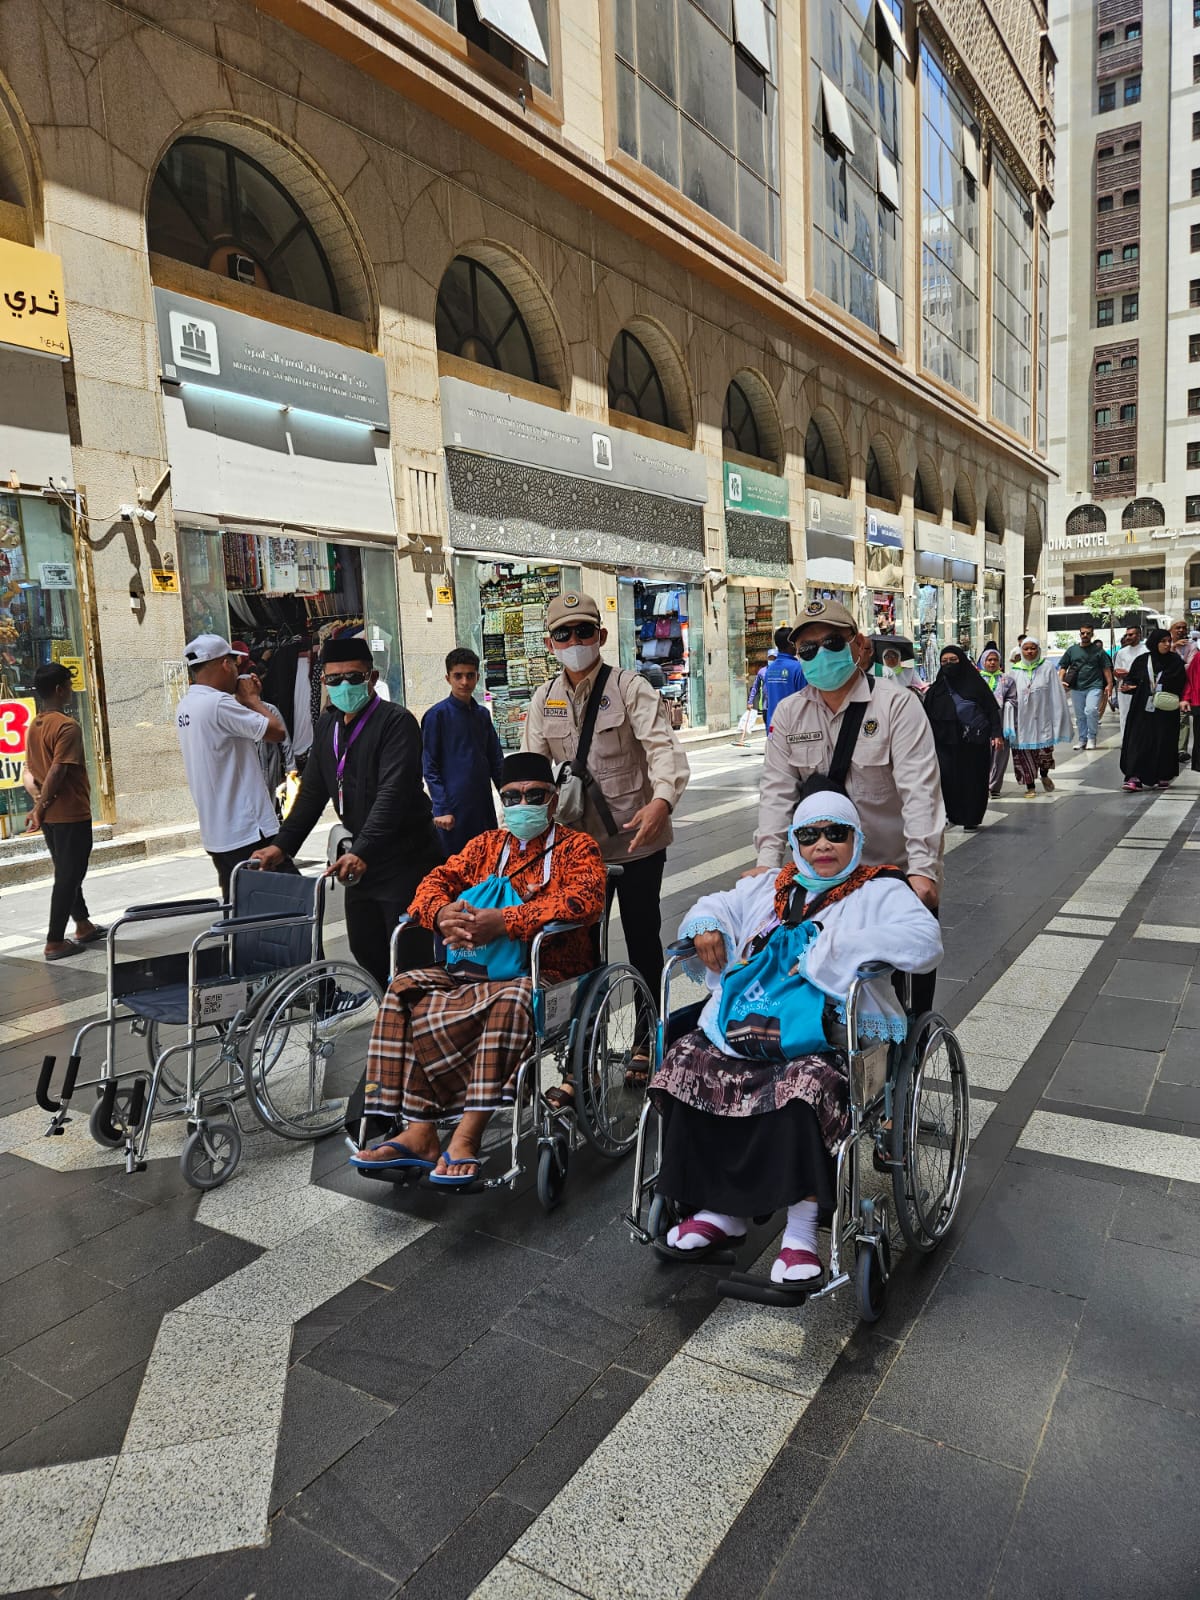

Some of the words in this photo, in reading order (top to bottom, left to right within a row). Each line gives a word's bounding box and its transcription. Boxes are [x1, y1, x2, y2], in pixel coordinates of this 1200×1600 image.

[4, 289, 60, 319] ثري
[1076, 534, 1110, 548] HOTEL
[0, 702, 29, 754] 3
[0, 757, 26, 782] Riy
